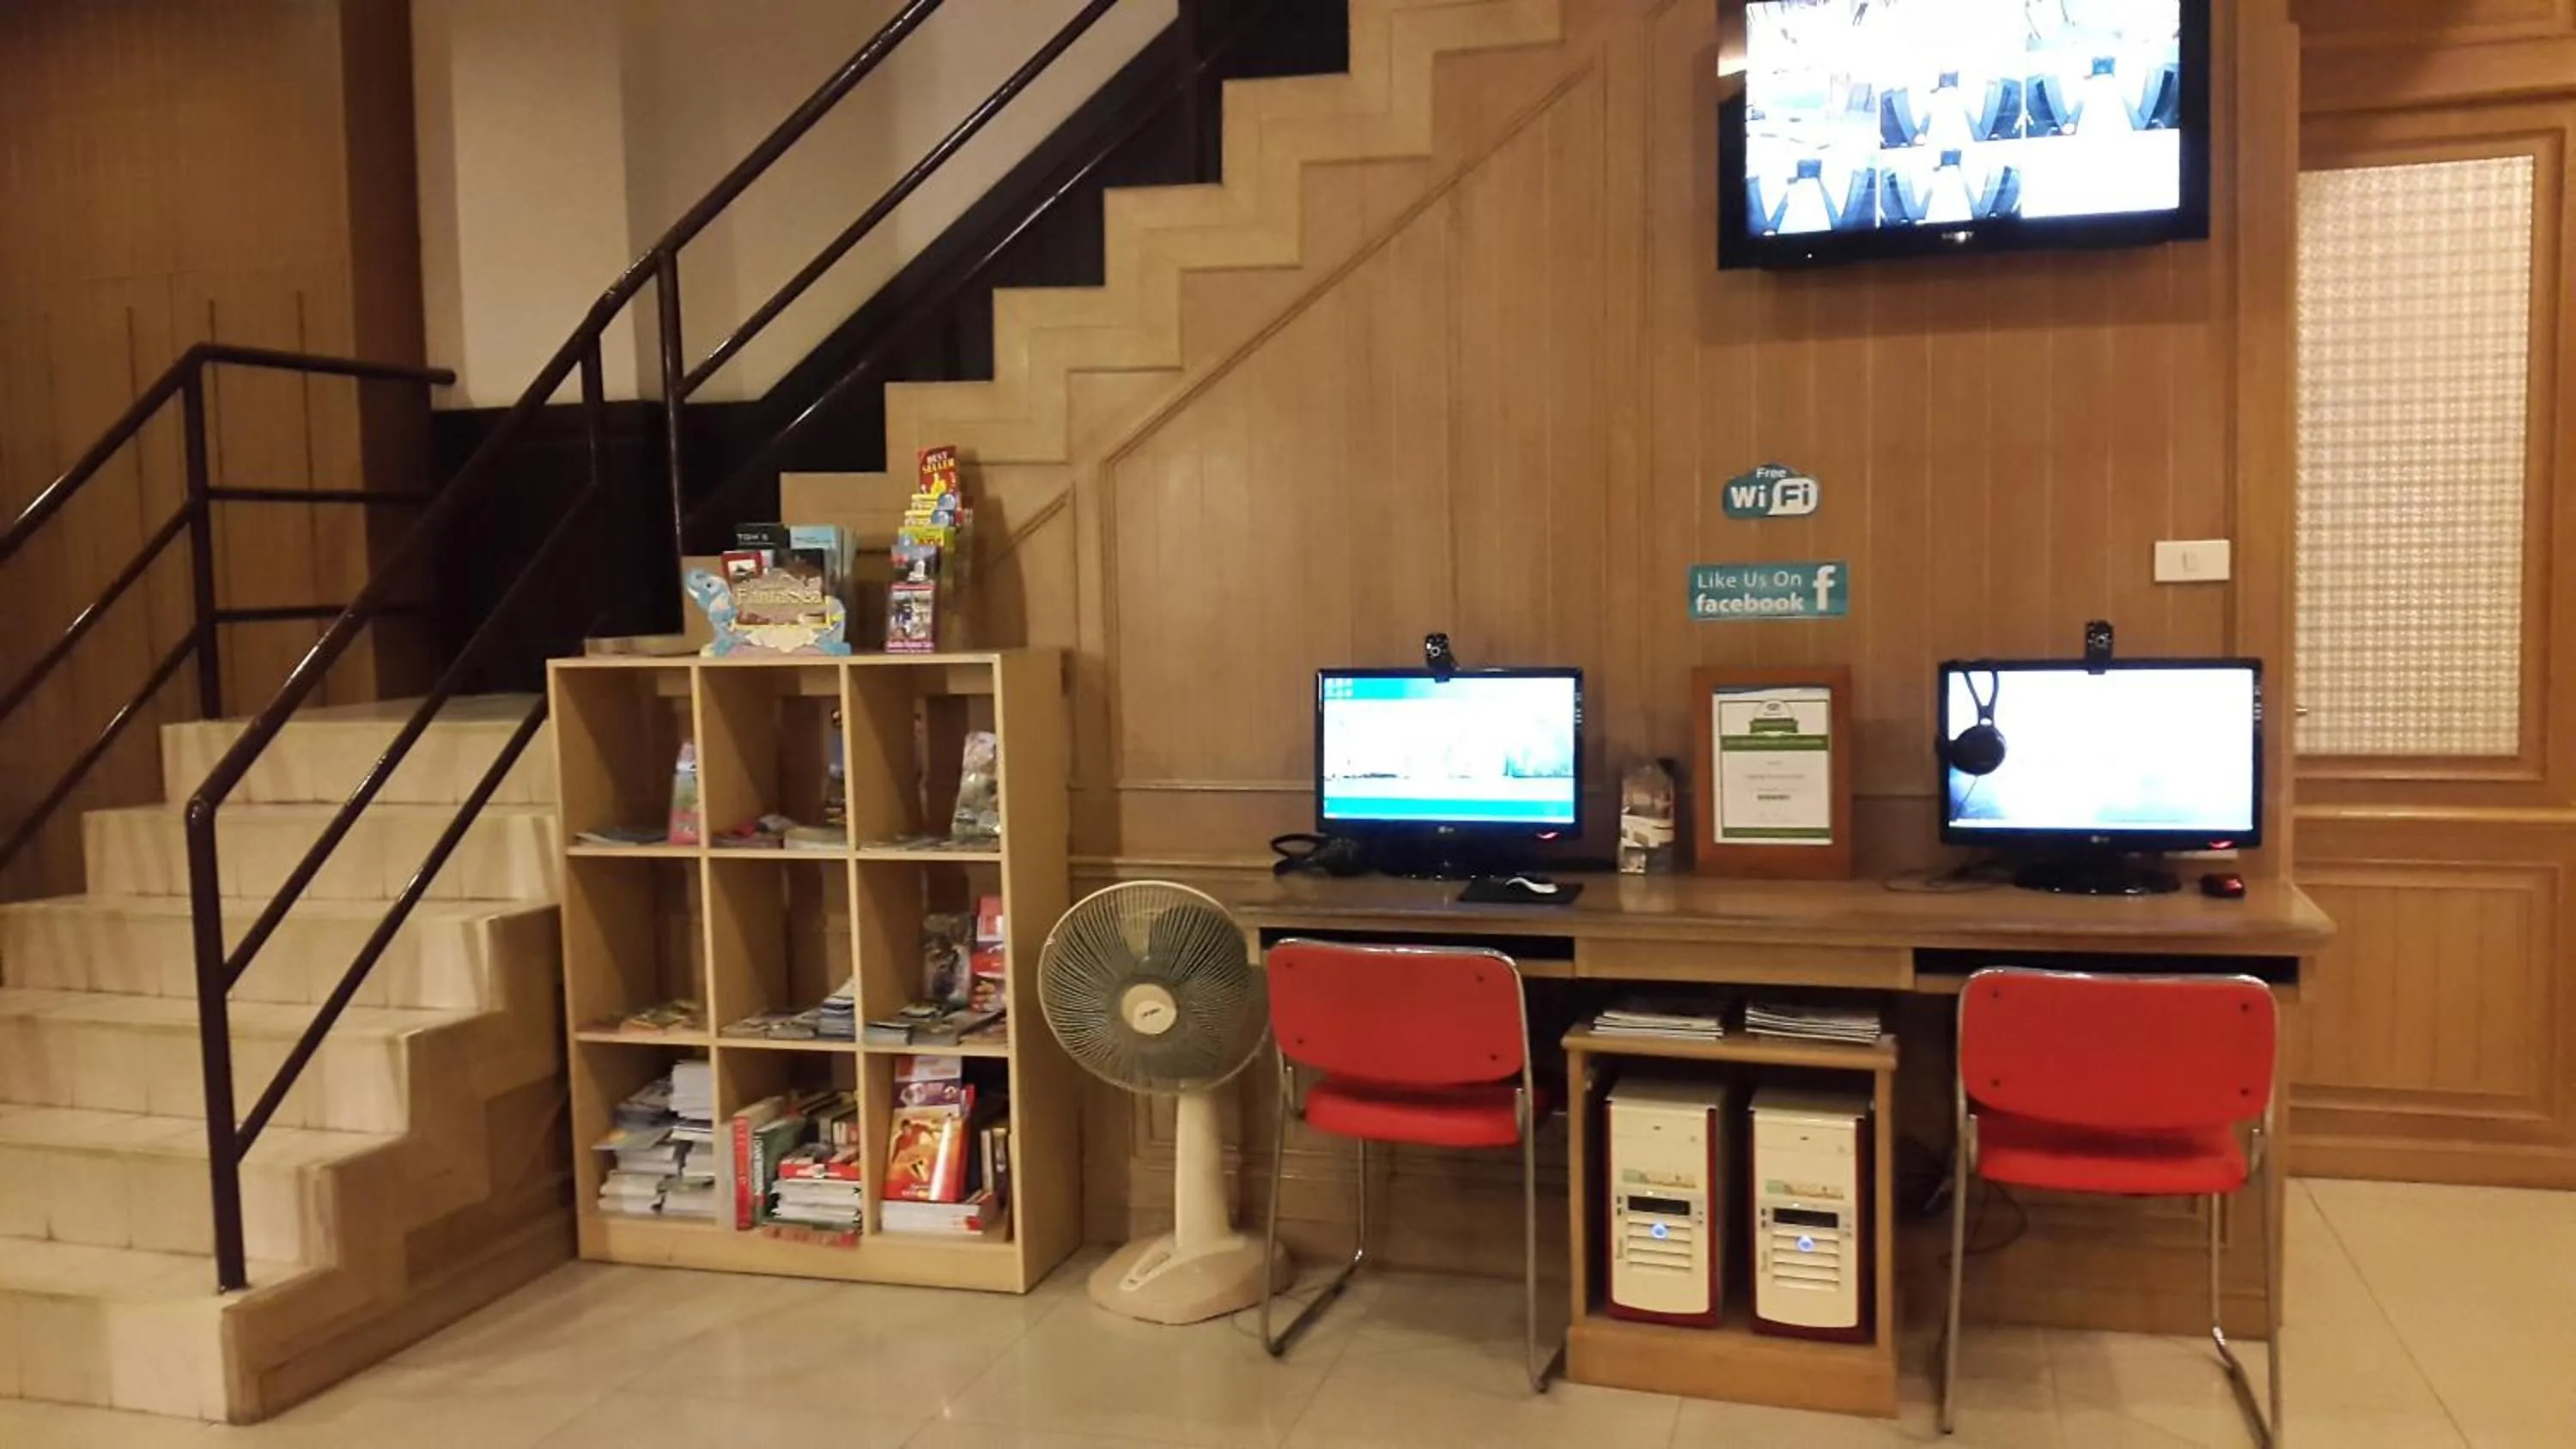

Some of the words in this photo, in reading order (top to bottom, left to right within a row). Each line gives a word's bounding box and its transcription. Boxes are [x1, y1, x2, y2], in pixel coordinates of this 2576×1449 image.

[1756, 467, 1787, 478] Free
[1698, 572, 1737, 589] Like
[1743, 571, 1767, 587] Us
[1772, 570, 1801, 587] On
[1696, 592, 1804, 613] facebook
